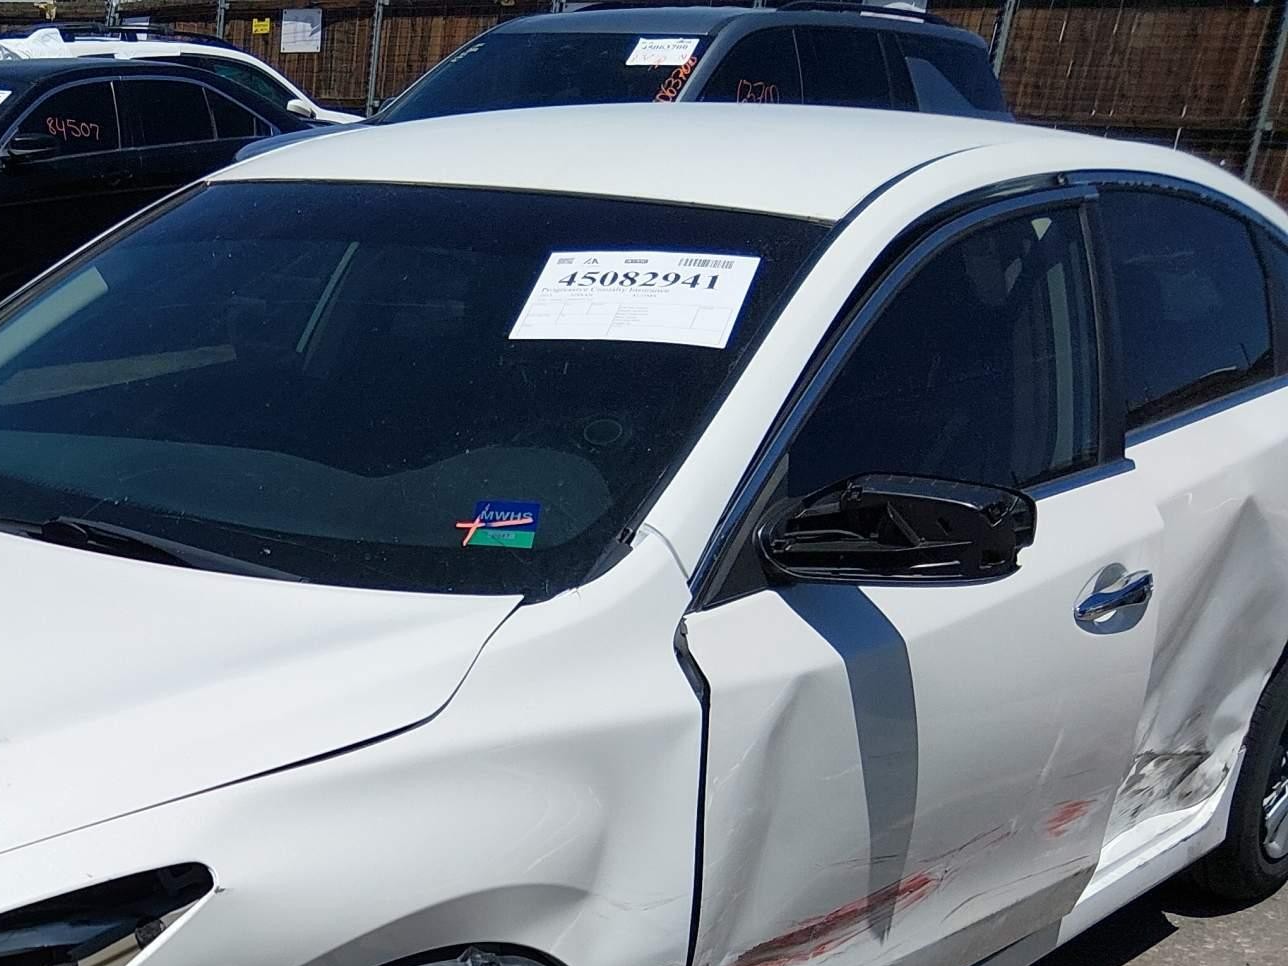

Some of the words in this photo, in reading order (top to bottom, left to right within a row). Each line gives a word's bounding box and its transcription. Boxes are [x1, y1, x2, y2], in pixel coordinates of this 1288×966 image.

[45, 116, 101, 142] 84507
[558, 270, 720, 290] 45082941
[480, 511, 533, 522] MWHS
